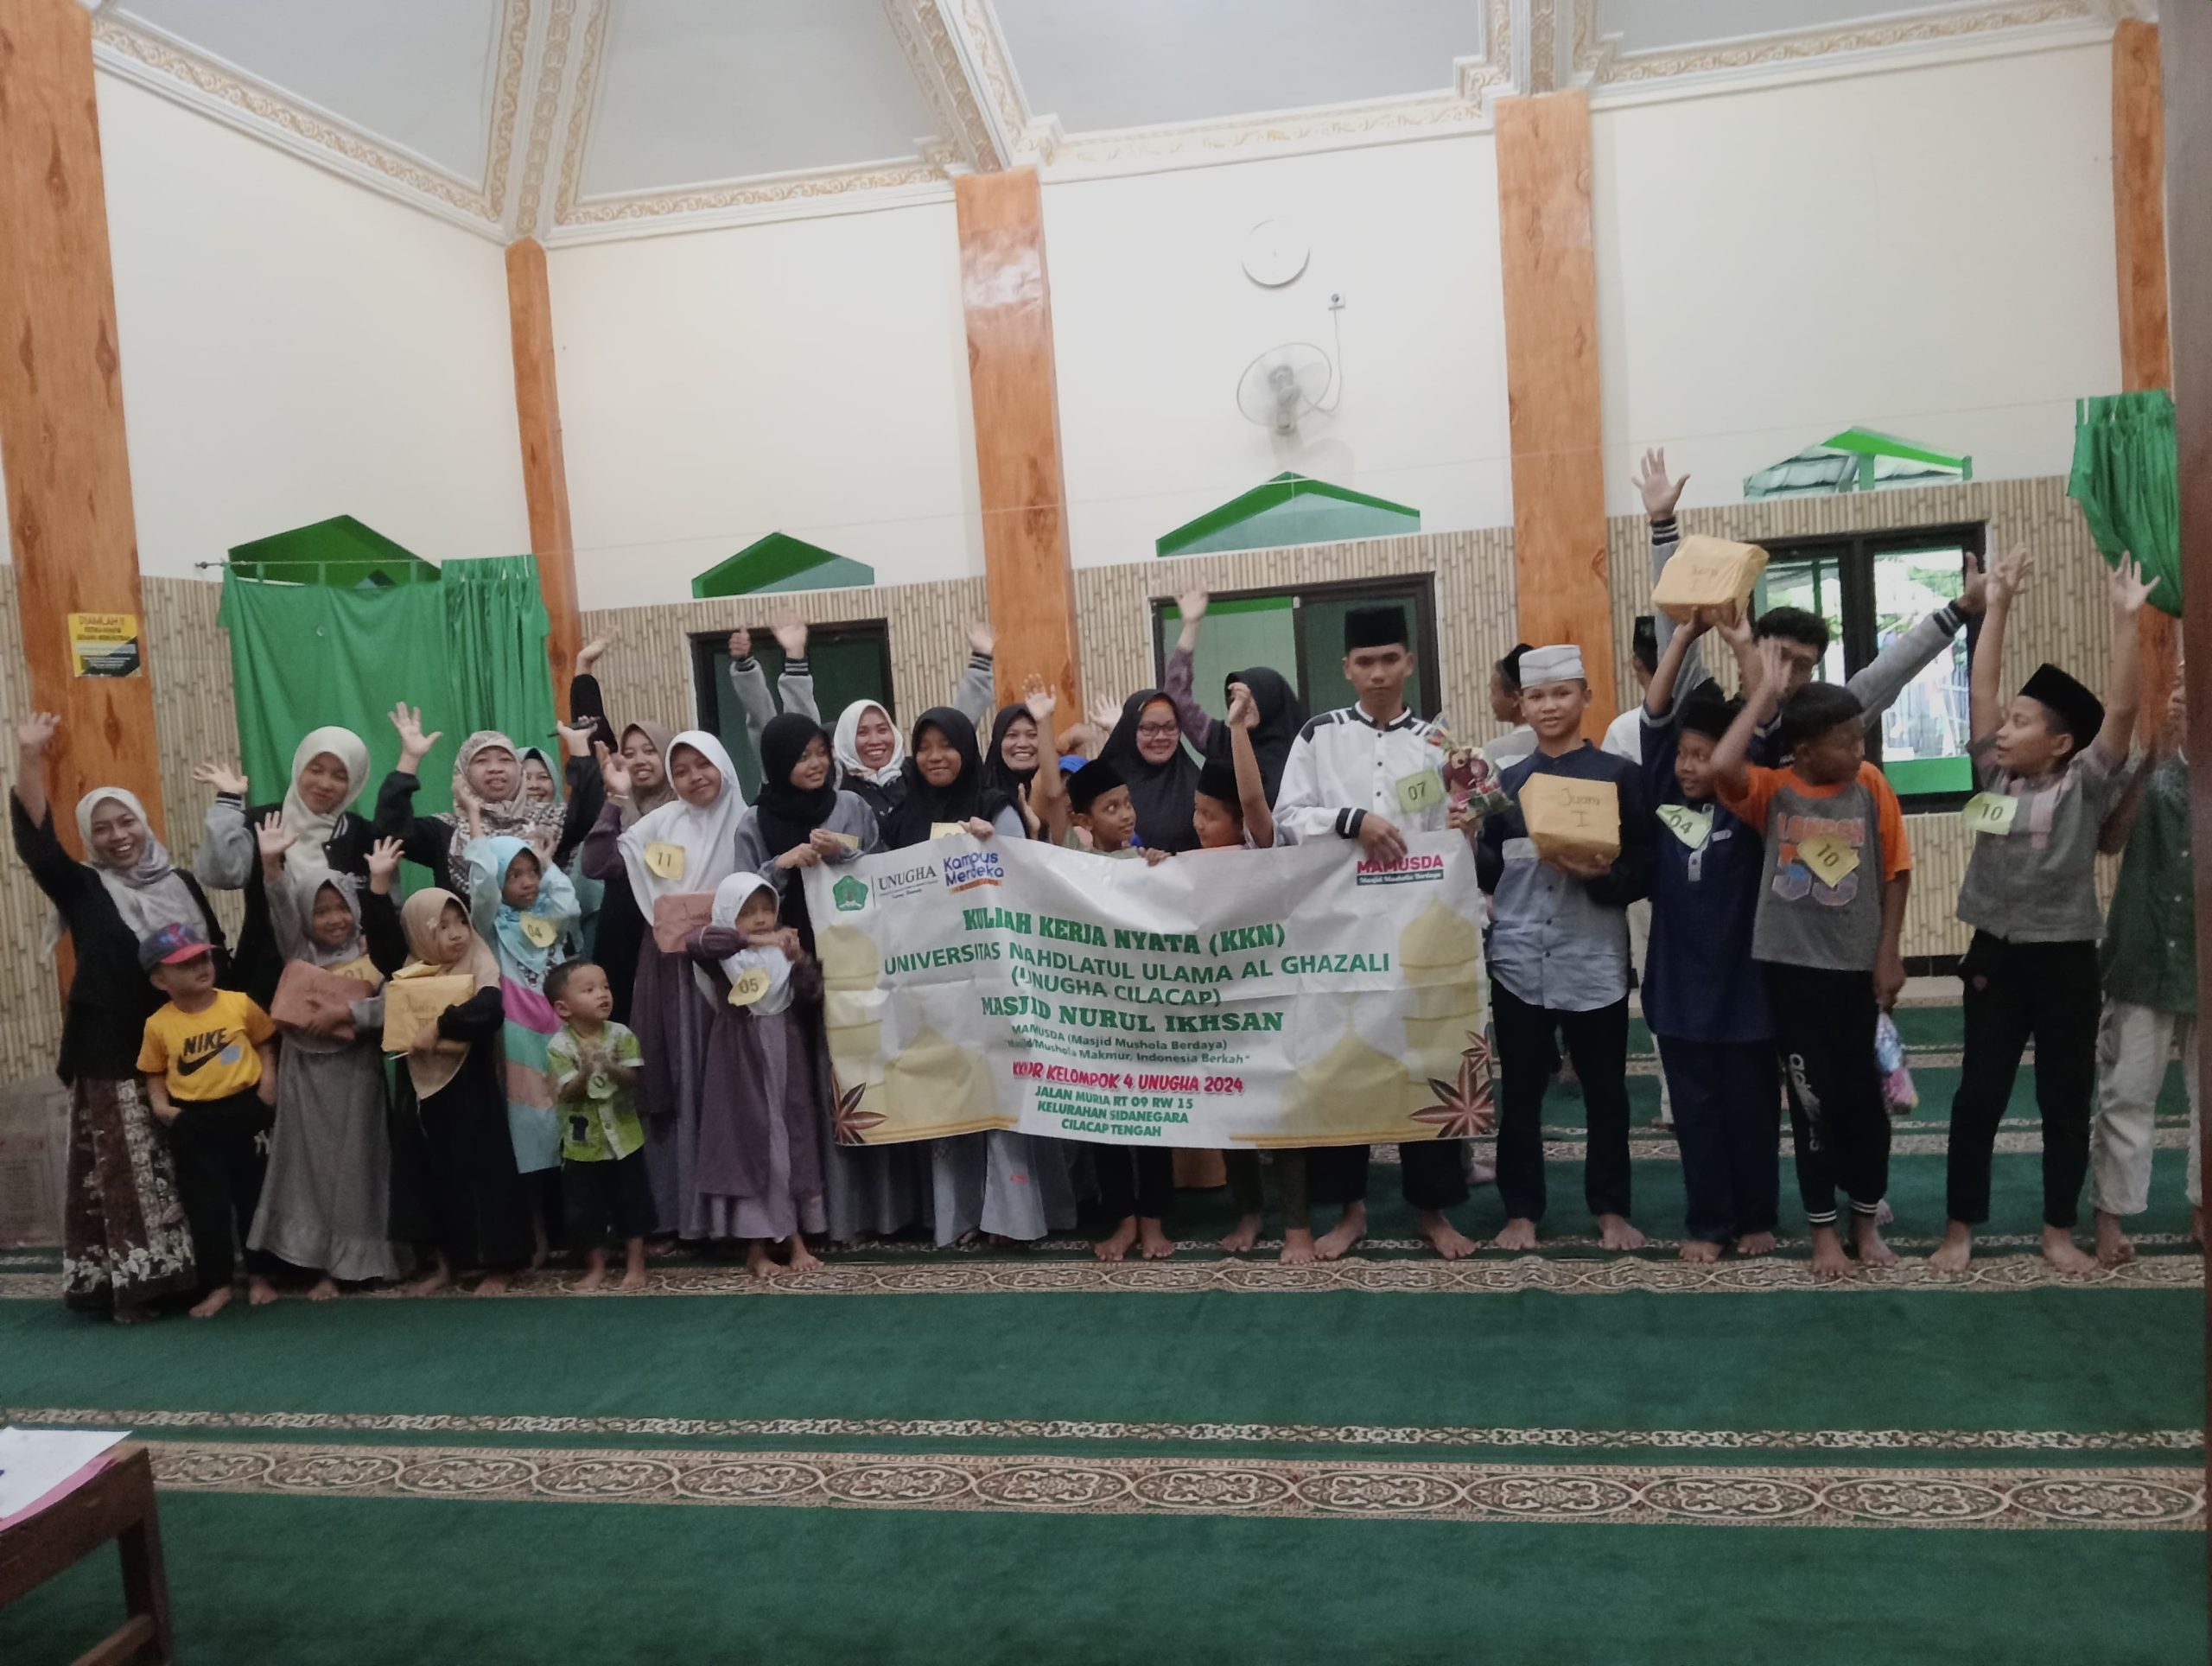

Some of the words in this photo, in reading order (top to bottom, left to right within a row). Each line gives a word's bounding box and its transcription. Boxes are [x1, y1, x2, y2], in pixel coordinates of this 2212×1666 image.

[1408, 780, 1426, 801] 07
[1981, 803, 2004, 821] 10
[1669, 814, 1694, 835] 04
[658, 852, 671, 868] 11
[943, 852, 999, 873] Kampus
[1357, 854, 1444, 874] MAMUSDA
[1817, 843, 1840, 868] 10
[878, 865, 937, 891] UNUGHA
[945, 866, 1004, 887] Merdeka
[527, 925, 543, 938] 04
[963, 907, 1032, 935] KULIAH
[1039, 915, 1108, 948] KERJA
[1114, 928, 1201, 955] NYATA
[1210, 923, 1285, 957] (KKN)
[885, 942, 1001, 976] UNIVERSITAS
[1009, 942, 1135, 980] NAHDLATUL
[1142, 963, 1234, 984] ULAMA
[1241, 959, 1274, 979] AL
[1281, 953, 1389, 975] GHAZALI
[739, 977, 760, 994] 05
[1011, 965, 1109, 998] (UNUGHA
[1114, 984, 1221, 1008] CILACAP)
[982, 995, 1052, 1020] MASJID
[1058, 1005, 1155, 1033] NURUL
[1165, 1012, 1284, 1033] IKHSAN
[183, 1027, 227, 1057] NIKE
[1068, 1034, 1112, 1047] (Masjid
[1171, 1039, 1227, 1052] Berdaya)
[1079, 1049, 1133, 1062] Makmur,
[1136, 1052, 1198, 1064] Indonesia
[1046, 1064, 1121, 1090] KELOMPOK
[1123, 1073, 1134, 1090] 4
[1138, 1074, 1199, 1092] UNUGHA
[1204, 1077, 1244, 1093] 2024
[1035, 1085, 1072, 1101] JALAN
[1075, 1091, 1111, 1106] MURIA
[1113, 1096, 1128, 1107] RT
[1131, 1097, 1148, 1107] 09
[1152, 1097, 1173, 1109] RW
[1177, 1097, 1193, 1110] 15
[1037, 1100, 1107, 1120] KELURAHAN
[1109, 1109, 1189, 1123] SIDANEGARA
[1061, 1118, 1109, 1134] CILACAP
[1111, 1124, 1161, 1136] TENGAH
